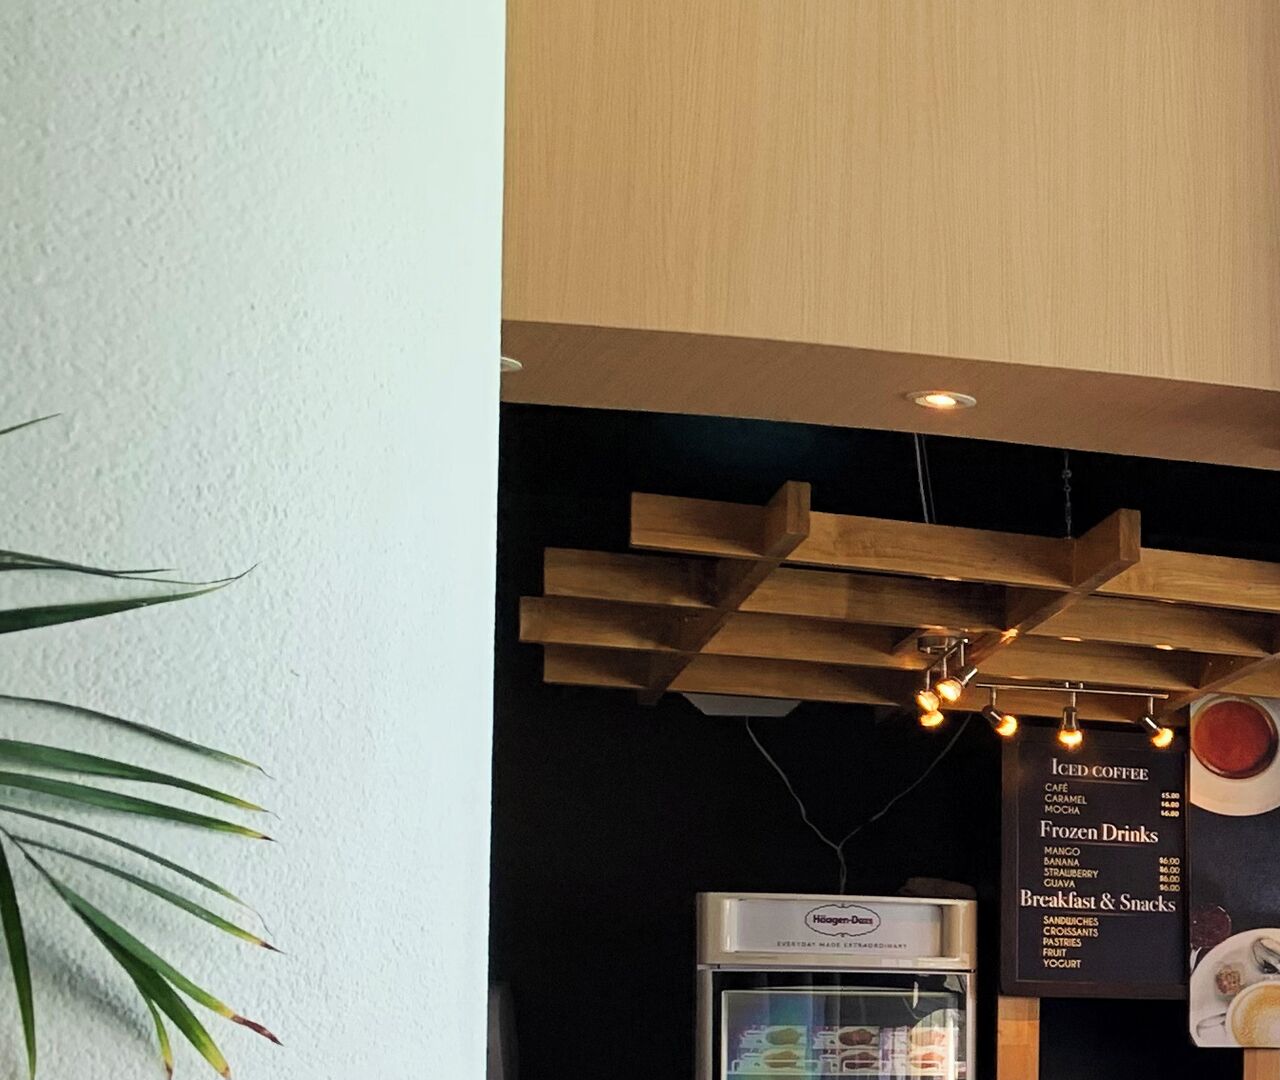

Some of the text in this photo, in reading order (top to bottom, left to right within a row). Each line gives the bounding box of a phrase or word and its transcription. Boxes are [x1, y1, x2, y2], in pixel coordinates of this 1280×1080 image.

[1052, 758, 1149, 781] ICED COFFEE
[1045, 794, 1087, 805] CARAMEL
[1045, 804, 1080, 815] MOCHA
[1040, 820, 1159, 843] Frozen Drinks
[1044, 846, 1081, 856] MANGO
[1043, 857, 1080, 867] BANANA
[1043, 868, 1099, 879] STRAWBERRY
[1043, 879, 1076, 889] GUAVA
[1020, 889, 1176, 913] Breakfast & Snacks
[1043, 916, 1099, 927] SANDWICHES
[1043, 927, 1099, 938] CROISSANTS
[1043, 937, 1082, 948] PASTRIES
[1043, 948, 1066, 957] FRUIT
[1043, 958, 1082, 968] YOGURT
